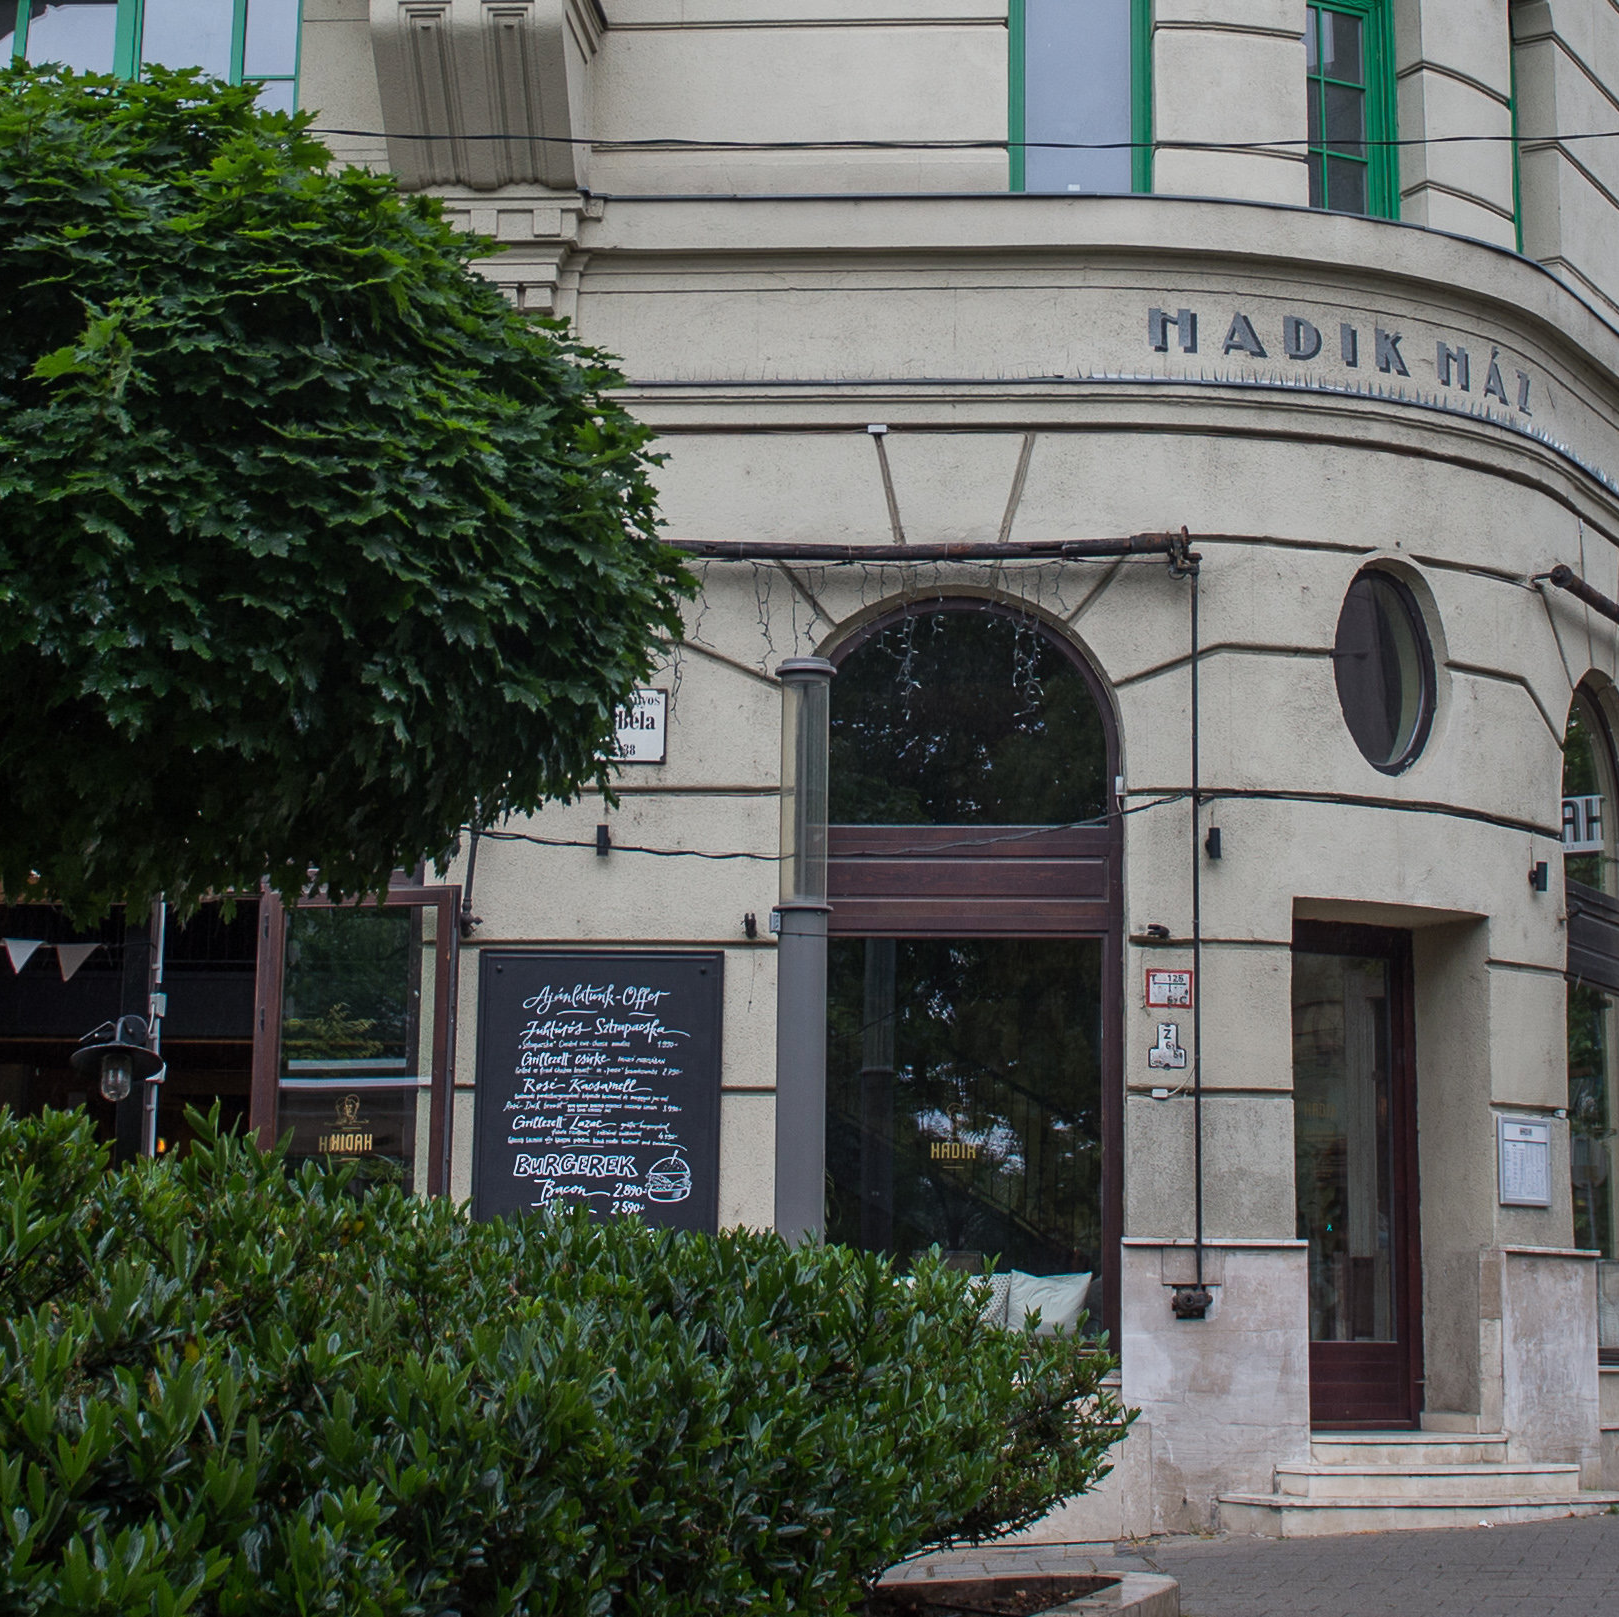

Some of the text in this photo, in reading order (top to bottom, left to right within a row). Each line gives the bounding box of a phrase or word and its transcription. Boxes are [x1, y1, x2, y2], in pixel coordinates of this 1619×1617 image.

[1148, 307, 1533, 416] HADIK HÁZ
[618, 710, 656, 730] Béla
[1164, 1029, 1171, 1039] Z
[930, 1142, 977, 1160] HADIK
[513, 1154, 639, 1177] BURGEREK
